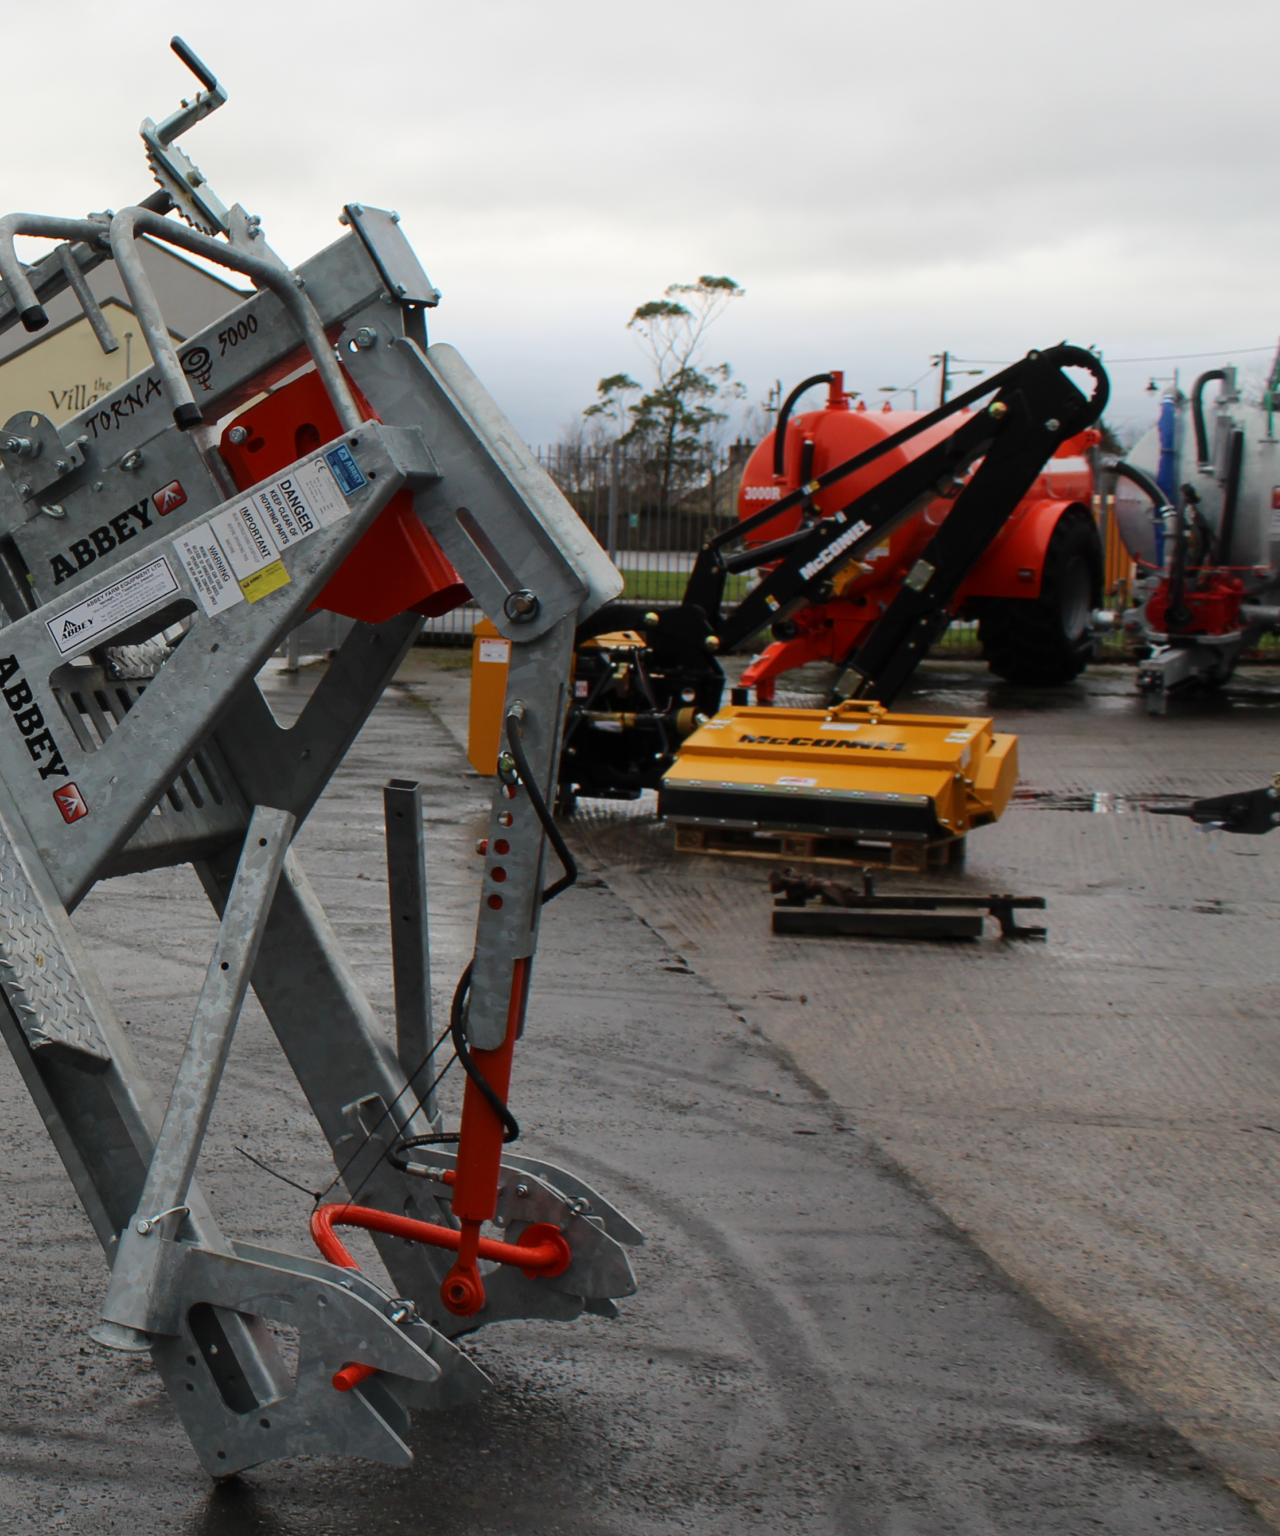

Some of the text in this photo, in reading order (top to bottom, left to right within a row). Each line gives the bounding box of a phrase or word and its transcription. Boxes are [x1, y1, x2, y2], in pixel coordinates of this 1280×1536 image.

[218, 314, 258, 356] 5000
[94, 376, 112, 391] the
[85, 376, 162, 438] TORNA
[268, 489, 298, 537] KEEP CLEAR OF
[279, 478, 314, 532] DANGER
[745, 487, 781, 500] 3000R
[240, 506, 271, 558] IMPORTANT
[258, 493, 289, 544] ROTATING PARTS
[49, 498, 153, 585] ABBEY
[208, 544, 231, 582] WARNING
[85, 562, 162, 607] ABBEY FARM EQUIPMENT LTD.
[59, 616, 96, 641] ABBEY
[737, 734, 907, 752] McCONNEL
